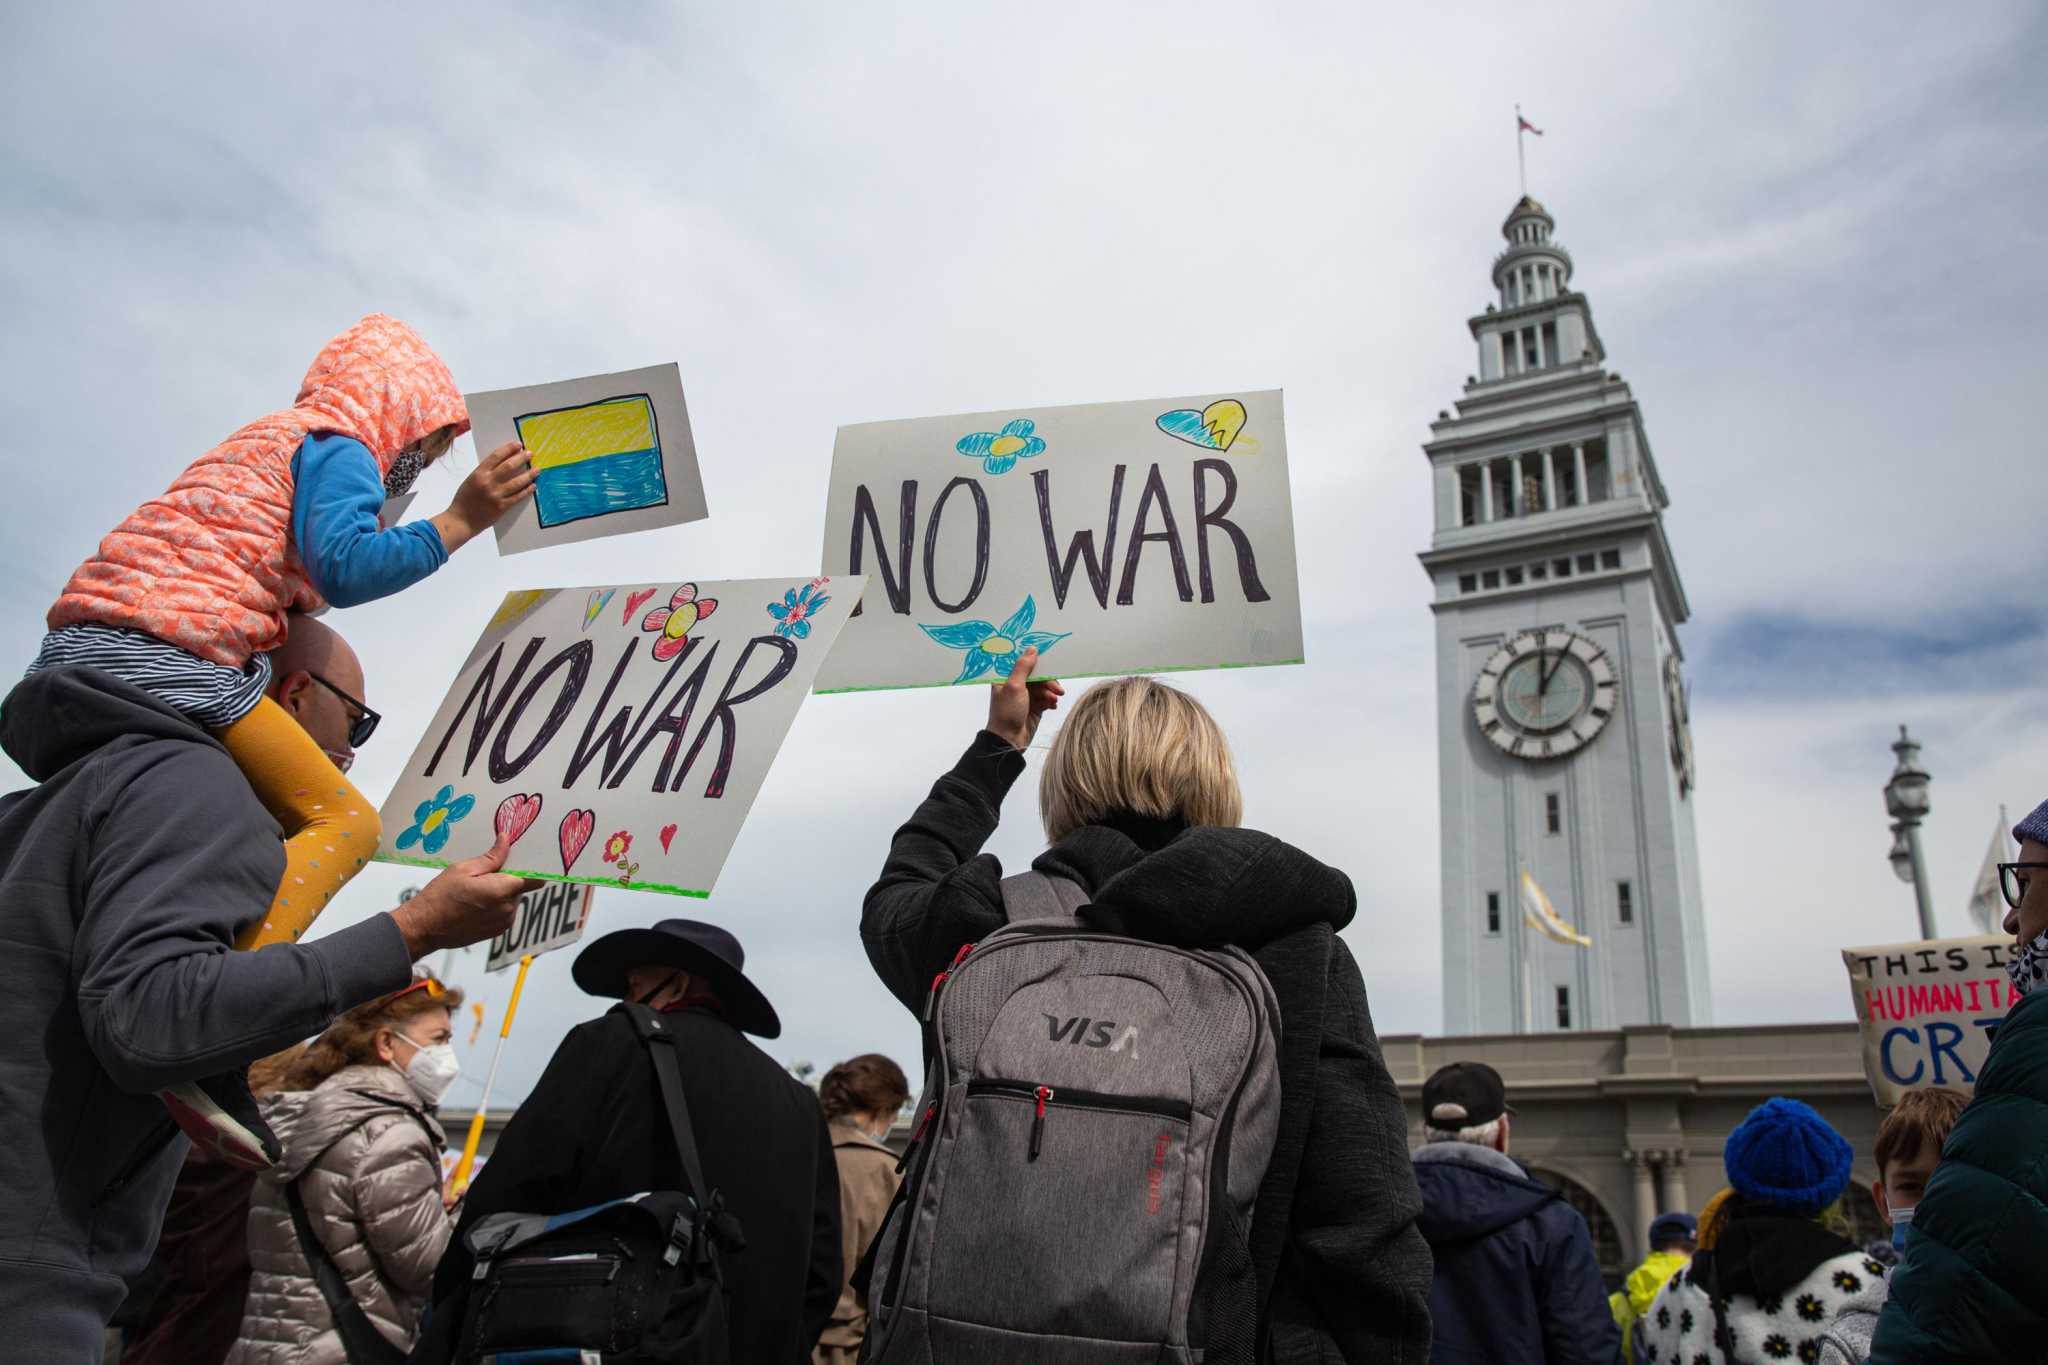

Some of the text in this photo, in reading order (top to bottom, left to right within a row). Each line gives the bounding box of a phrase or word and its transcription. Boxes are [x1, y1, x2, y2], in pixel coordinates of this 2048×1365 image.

[848, 457, 1272, 617] NO WAR
[422, 635, 799, 799] NO WAR
[1857, 948, 1969, 978] THIS
[1041, 1012, 1139, 1060] VISA
[1880, 1017, 2004, 1086] CR
